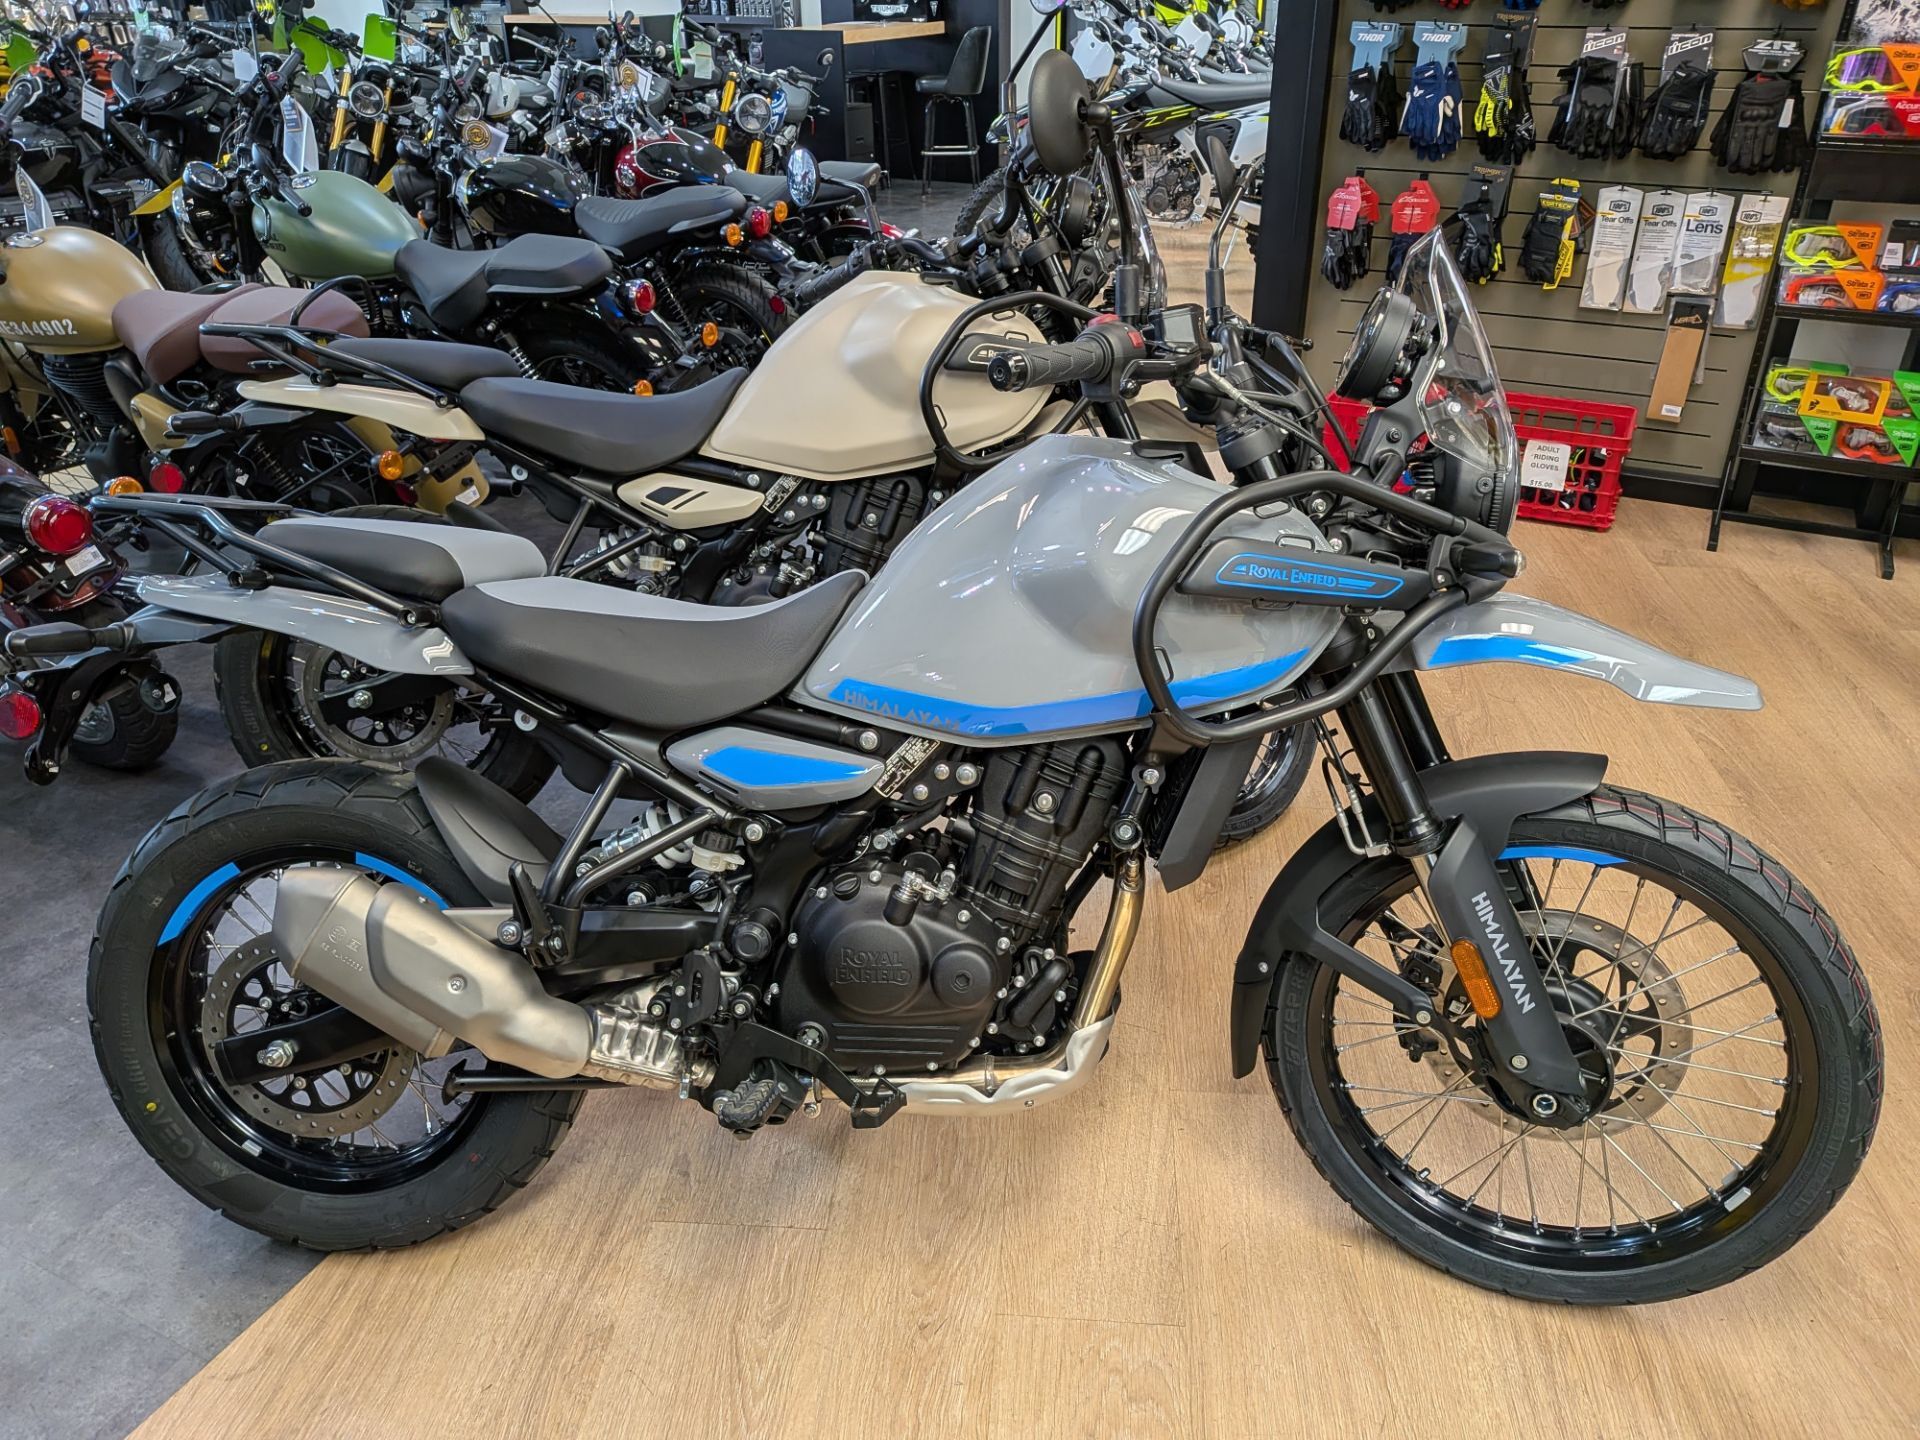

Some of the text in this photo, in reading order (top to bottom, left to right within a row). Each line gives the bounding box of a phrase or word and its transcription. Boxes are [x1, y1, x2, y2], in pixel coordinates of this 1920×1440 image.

[1356, 33, 1386, 42] THOR
[1421, 33, 1453, 43] THOR
[1601, 215, 1634, 225] Tear Offs
[1643, 219, 1677, 228] Tear Offs
[1685, 218, 1724, 235] Lens
[1847, 230, 1869, 238] Strata
[1846, 279, 1868, 288] Strata
[1537, 445, 1560, 454] ADULT
[1533, 454, 1560, 463] RIDING
[1530, 463, 1559, 471] GLOVES
[1530, 480, 1553, 488] $15.00
[1249, 564, 1337, 588] ROYAL ENFIELD
[844, 689, 961, 732] HIMALAYAN
[841, 947, 903, 967] ROYAL
[1471, 891, 1536, 1015] HIMALAYAN
[834, 967, 912, 986] ENFIELD
